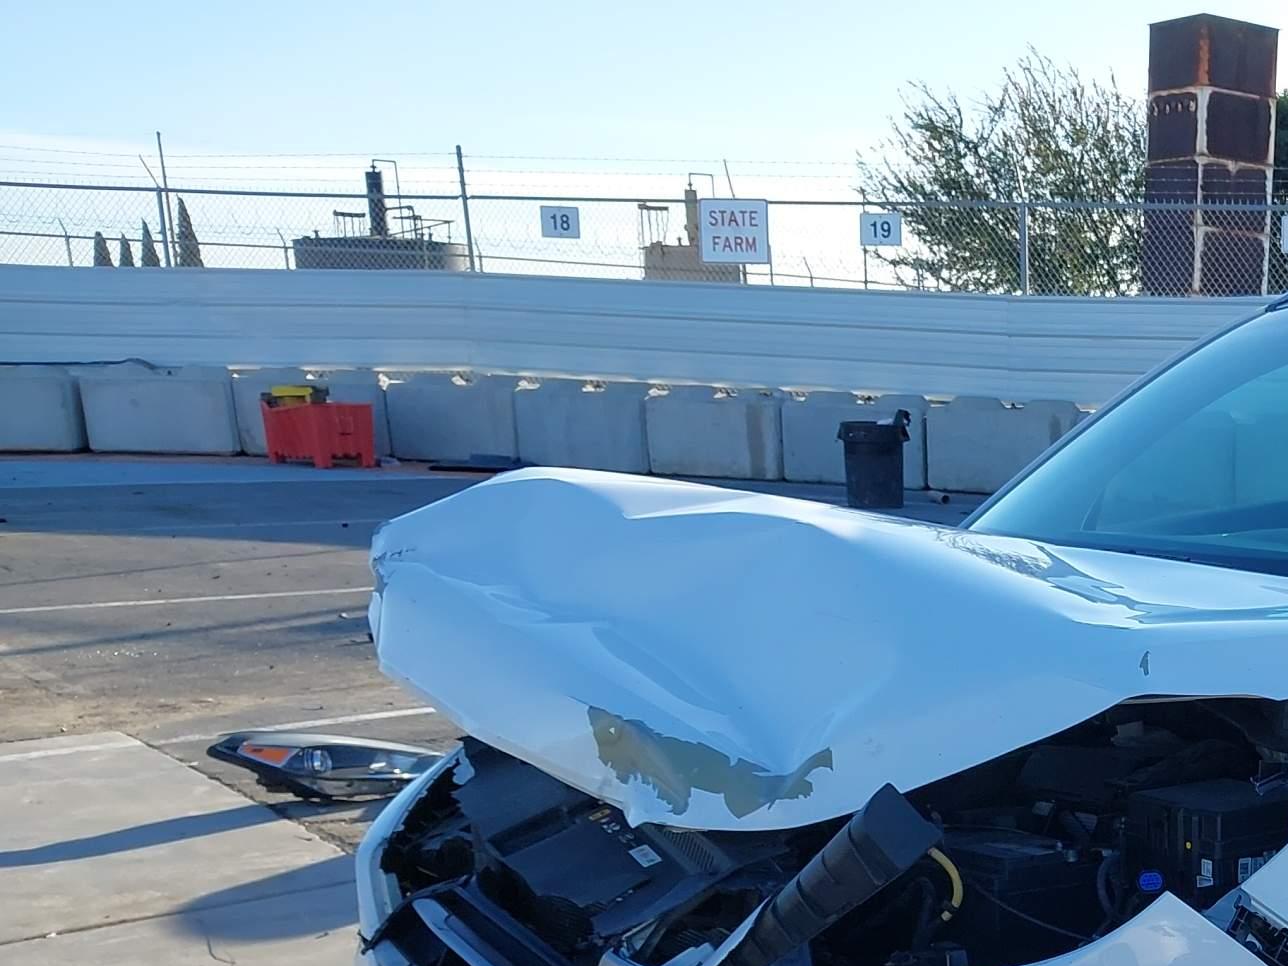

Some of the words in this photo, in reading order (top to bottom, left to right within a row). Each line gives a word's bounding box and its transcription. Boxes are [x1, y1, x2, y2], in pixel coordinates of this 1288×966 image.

[550, 213, 570, 231] 18
[708, 209, 759, 228] STATE
[870, 220, 891, 239] 19
[712, 235, 757, 253] FARM
